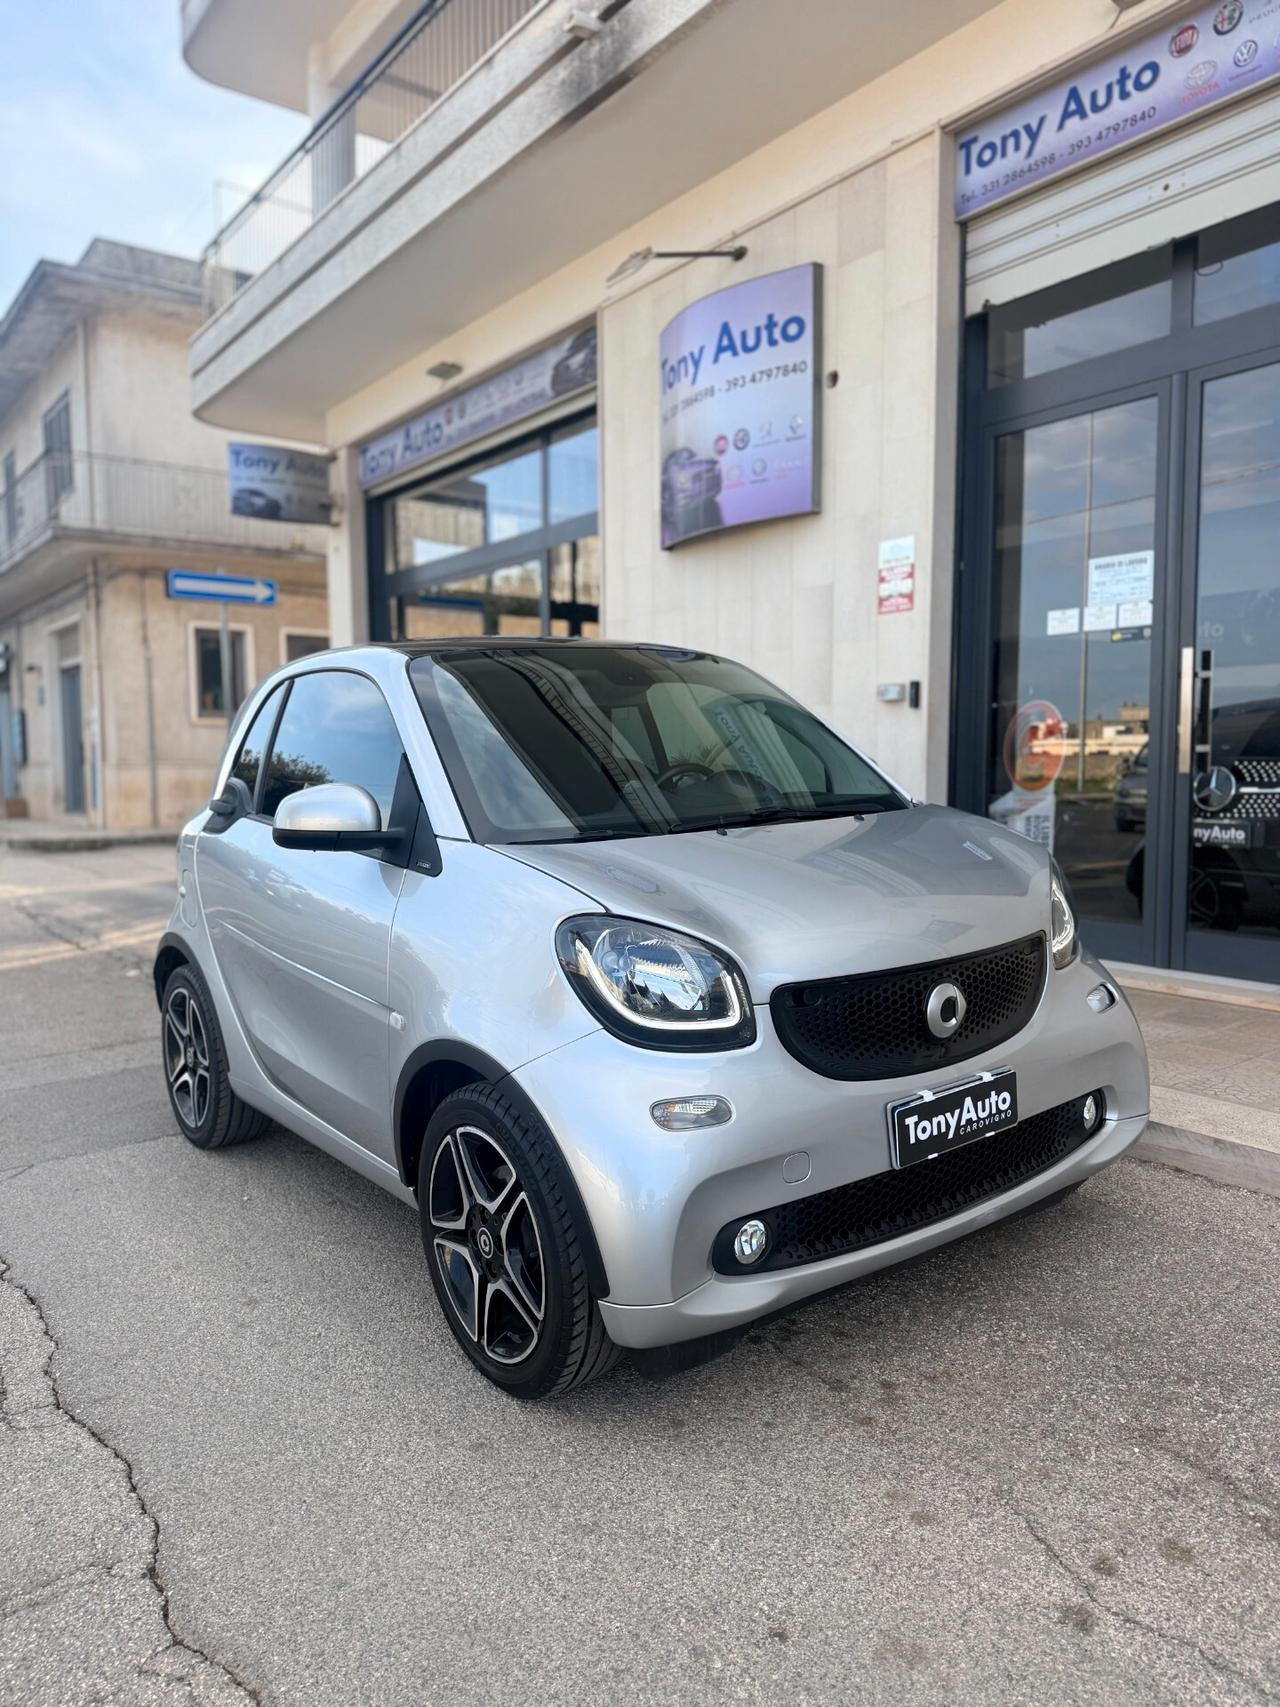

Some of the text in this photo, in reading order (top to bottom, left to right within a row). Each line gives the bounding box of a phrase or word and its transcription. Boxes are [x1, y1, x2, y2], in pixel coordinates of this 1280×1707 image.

[959, 60, 1161, 177] Tony Auto
[960, 190, 979, 205] Tel.
[981, 179, 1000, 195] 331
[1002, 152, 1055, 186] 2864598
[1067, 137, 1092, 157] 393
[1095, 106, 1157, 142] 4797840
[661, 313, 806, 395] Tony Auto
[725, 375, 746, 392] 393
[750, 360, 808, 384] 4797840
[232, 449, 279, 474] Tony
[360, 444, 398, 482] Tony
[401, 421, 444, 455] Auto
[905, 1091, 1011, 1144] TonyAuto
[960, 1110, 1012, 1135] CAROVIGNO
